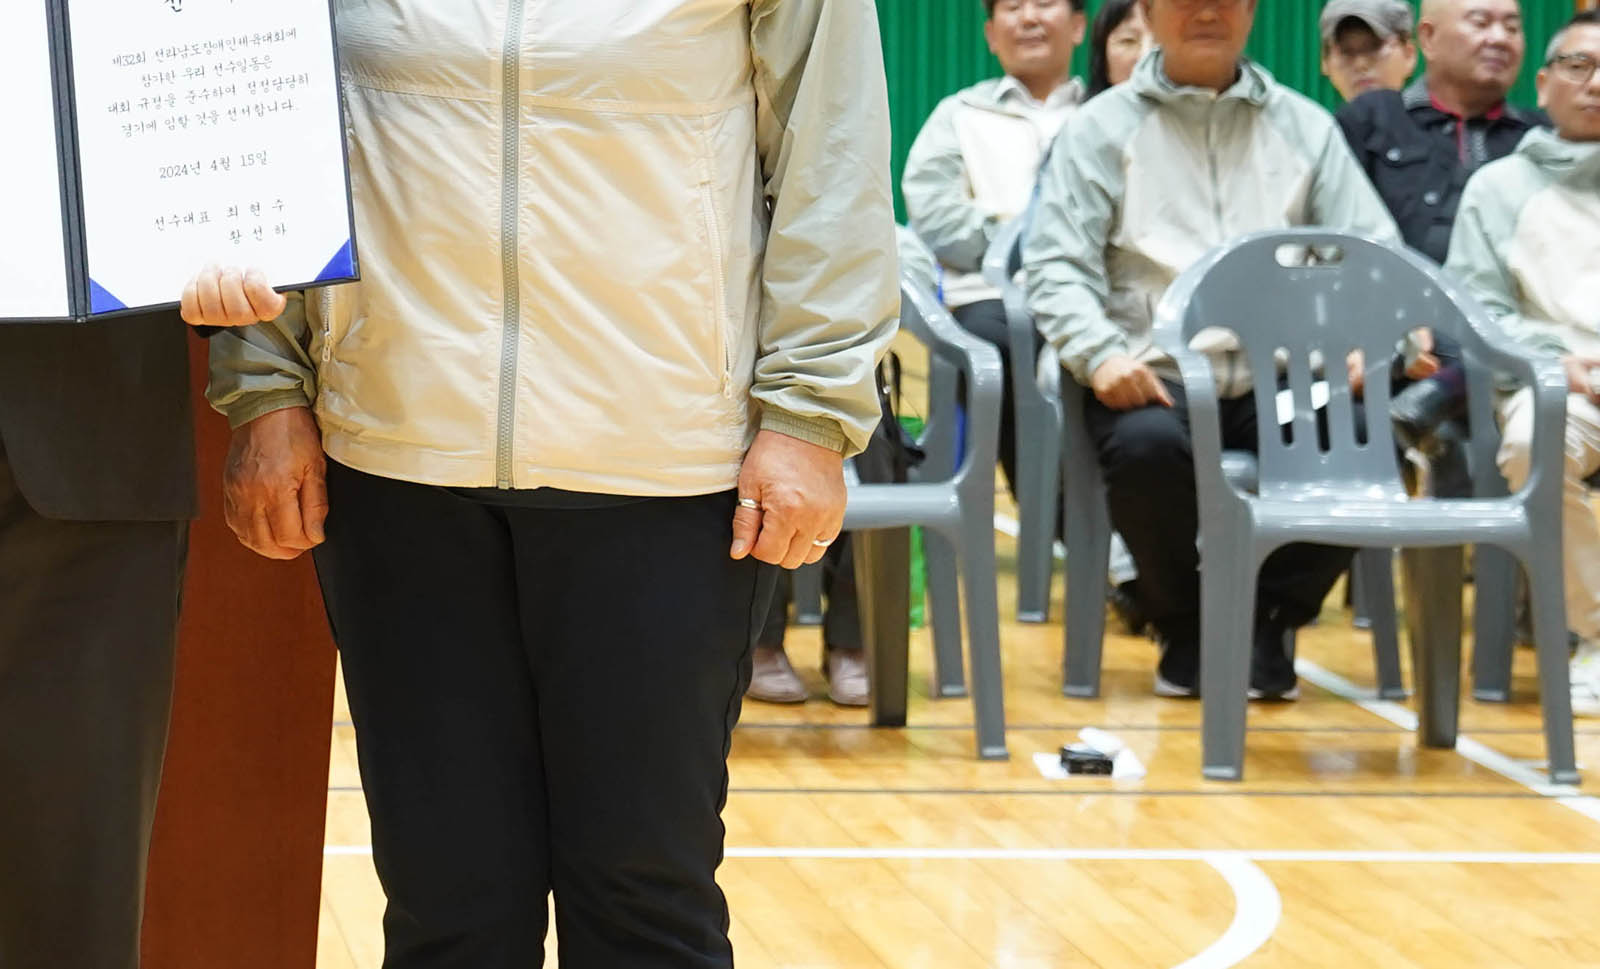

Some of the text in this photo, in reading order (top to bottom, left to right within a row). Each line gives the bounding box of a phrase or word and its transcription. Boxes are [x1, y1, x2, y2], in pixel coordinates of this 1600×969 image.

[159, 150, 267, 179] 2024년 4월 15일
